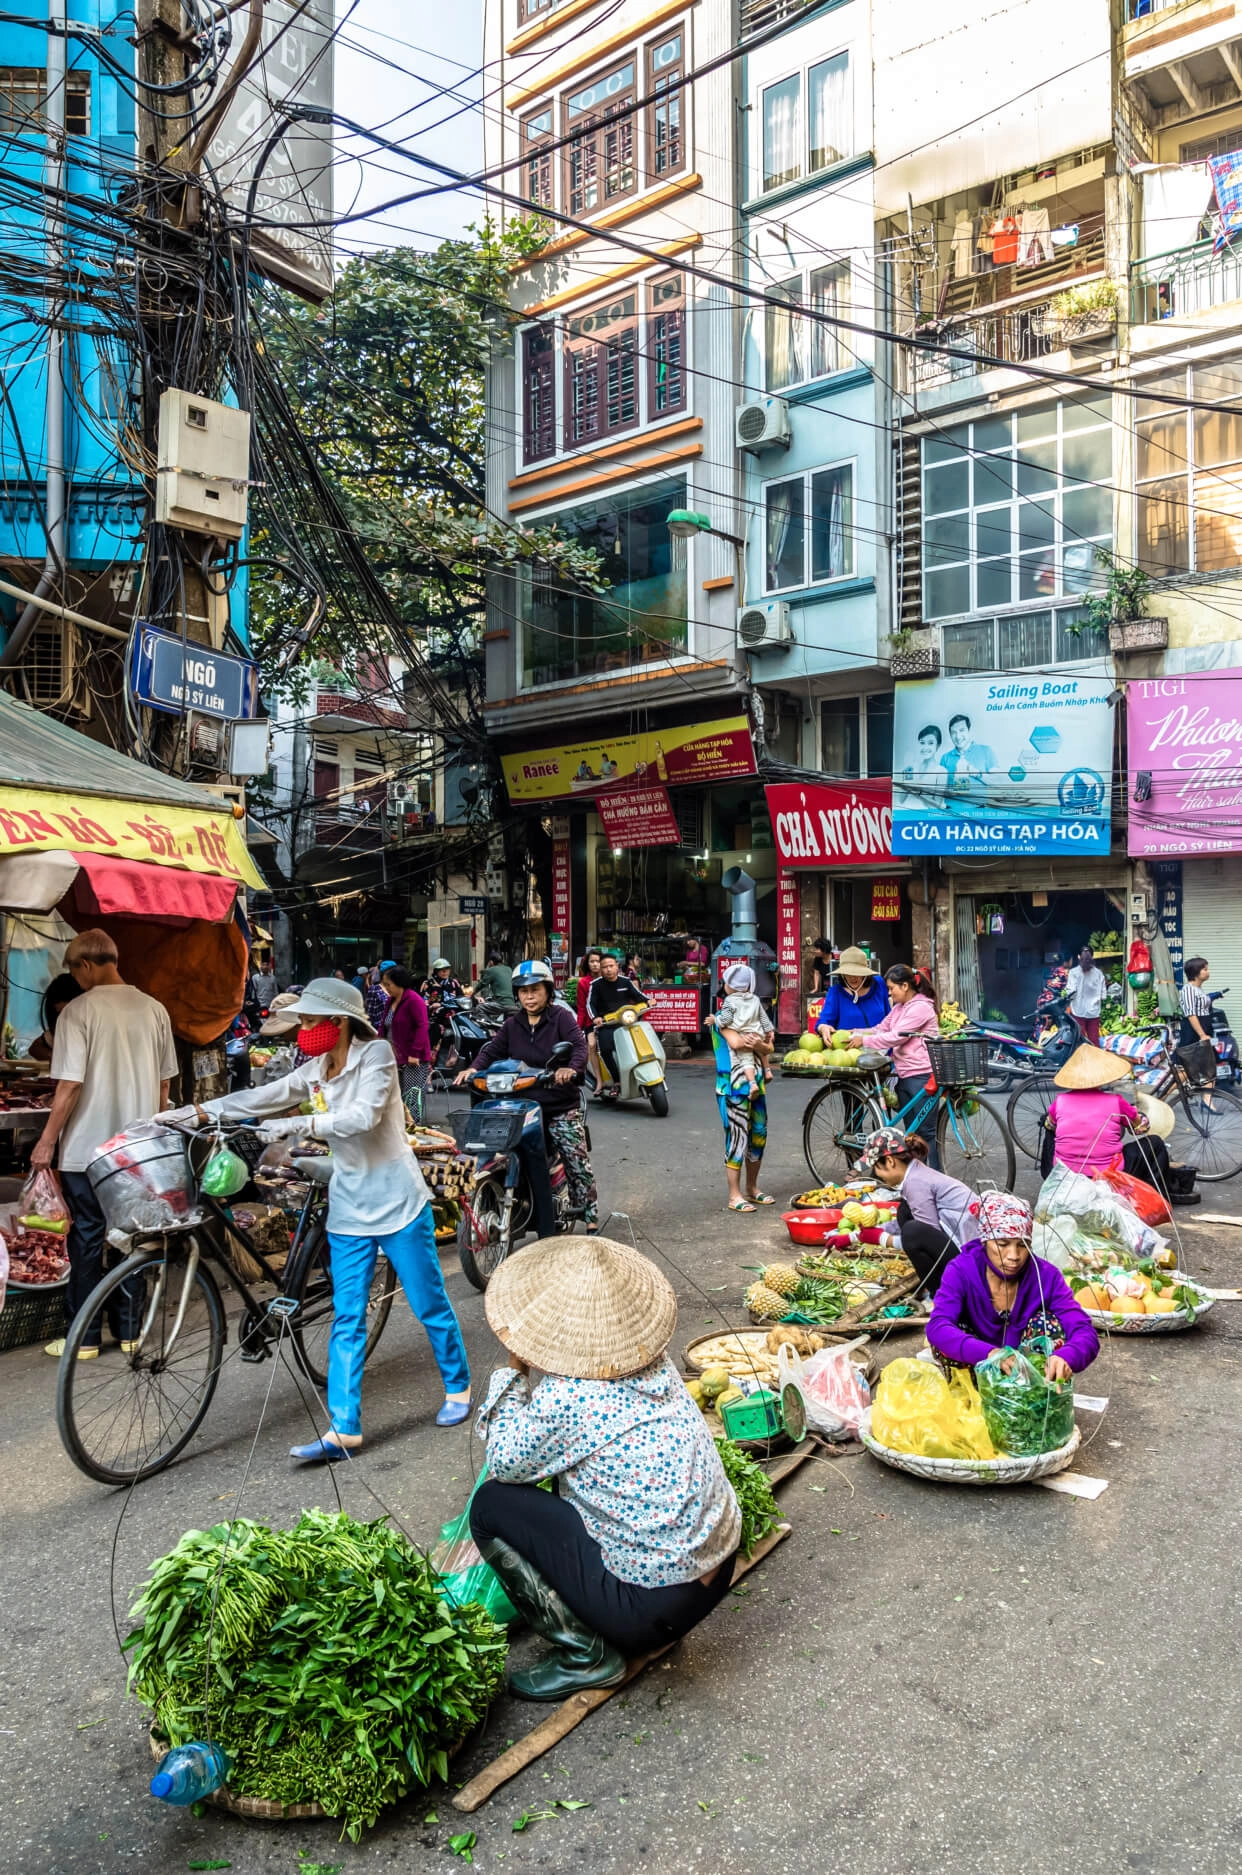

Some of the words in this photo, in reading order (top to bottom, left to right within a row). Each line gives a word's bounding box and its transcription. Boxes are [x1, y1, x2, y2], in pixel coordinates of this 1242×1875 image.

[181, 660, 216, 688] NGÕ
[987, 684, 1038, 700] Sailing
[1042, 681, 1079, 696] Boat
[1138, 678, 1187, 698] TIGI
[205, 693, 225, 711] LIÊN
[523, 762, 559, 780] Ranee
[51, 807, 118, 847] BÒ
[776, 792, 821, 858] CHẢ
[901, 821, 941, 841] CỬA
[946, 822, 1004, 840] HÀNG
[1008, 824, 1046, 844] TẠP
[1052, 821, 1100, 840] HÓA
[1143, 844, 1158, 853] 20
[1207, 839, 1233, 850] LIÊN
[782, 908, 794, 918] TAY
[783, 932, 794, 946] HẢI
[782, 946, 795, 961] SẢN
